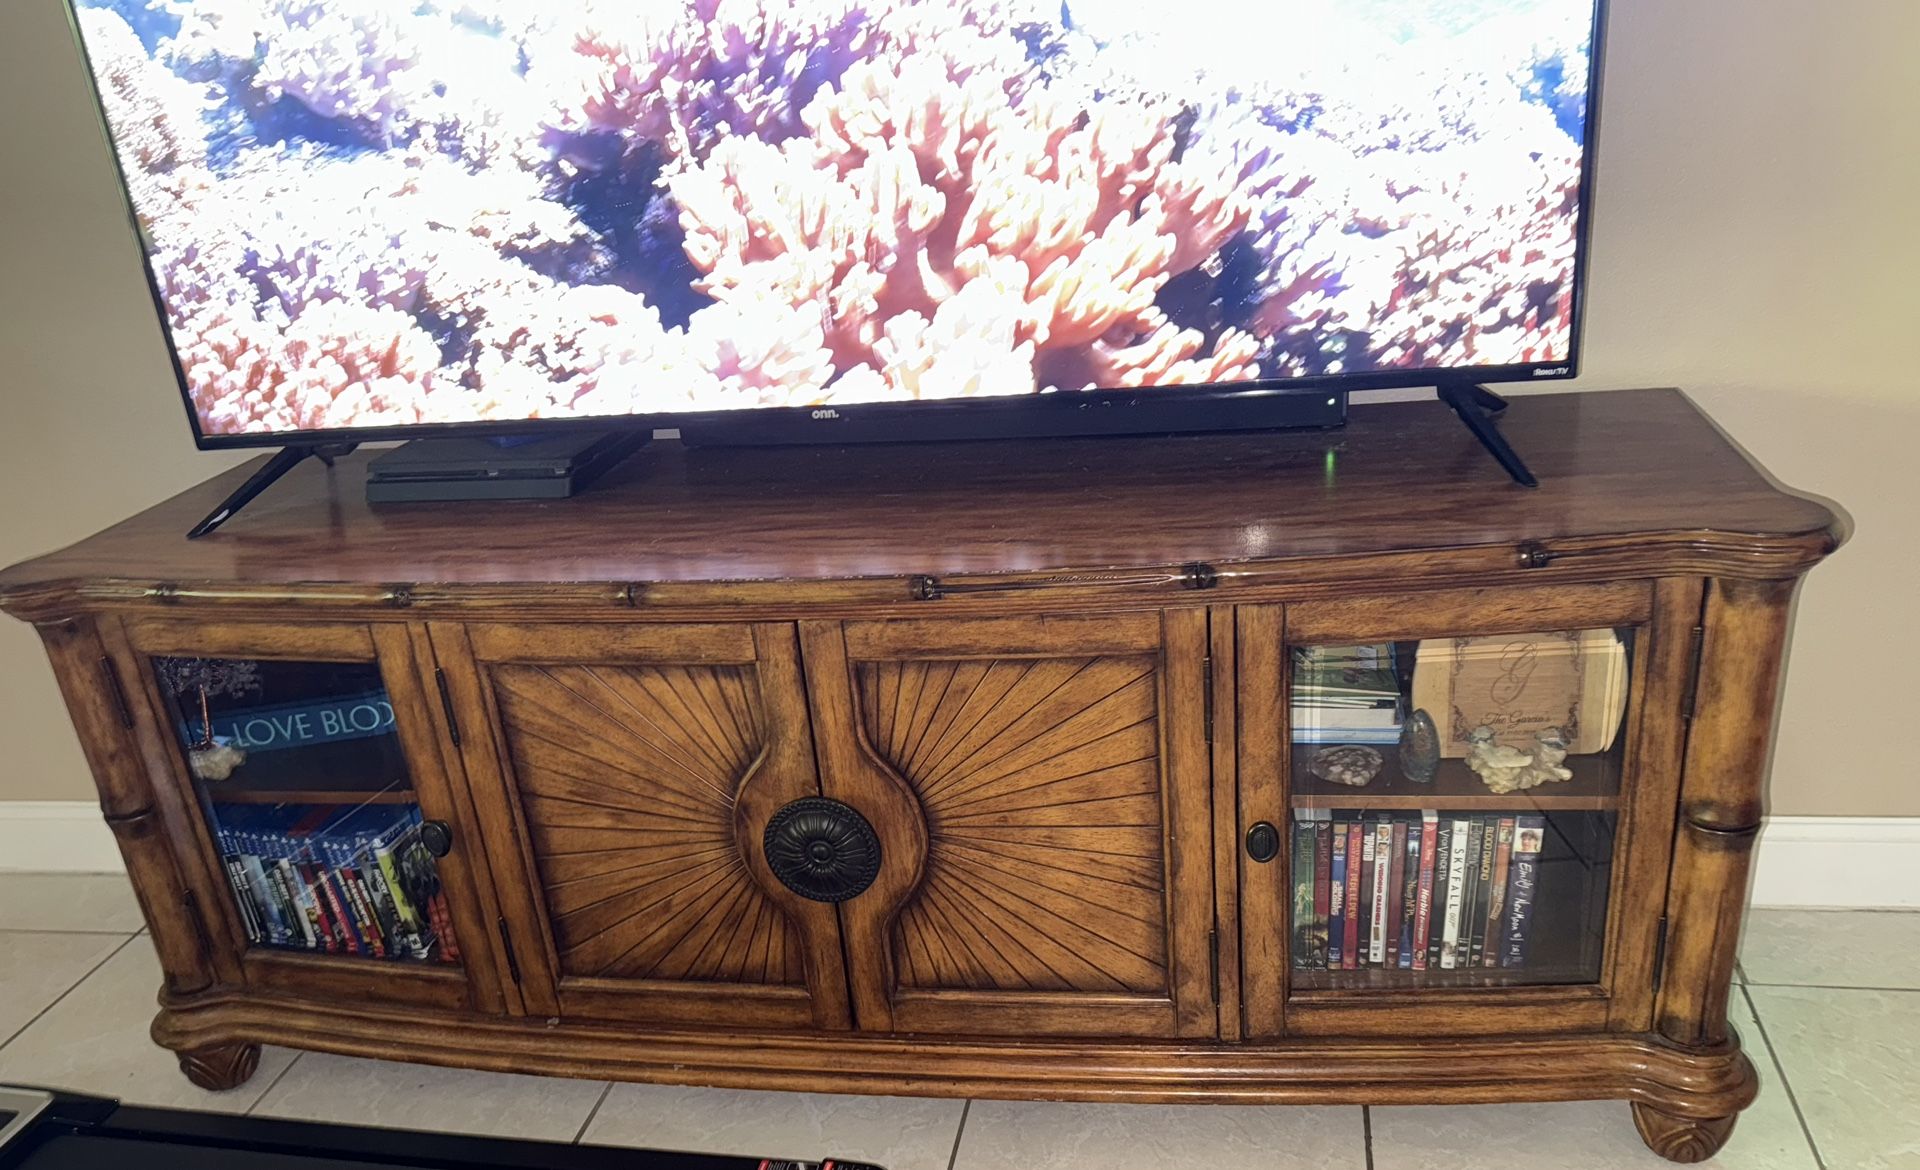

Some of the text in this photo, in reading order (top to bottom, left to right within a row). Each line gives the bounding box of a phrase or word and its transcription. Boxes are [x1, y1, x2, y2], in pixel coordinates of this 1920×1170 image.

[1532, 366, 1569, 377] Roku TV
[811, 408, 840, 419] onn.
[233, 713, 313, 747] LOVE
[1480, 711, 1506, 726] The
[1437, 846, 1449, 882] VENDETTA
[1480, 826, 1494, 881] BLOOD DIAMOND
[1374, 863, 1385, 926] WEDDING CRASHERS
[1449, 848, 1465, 909] SKYFALL
[1419, 888, 1431, 917] Herbie
